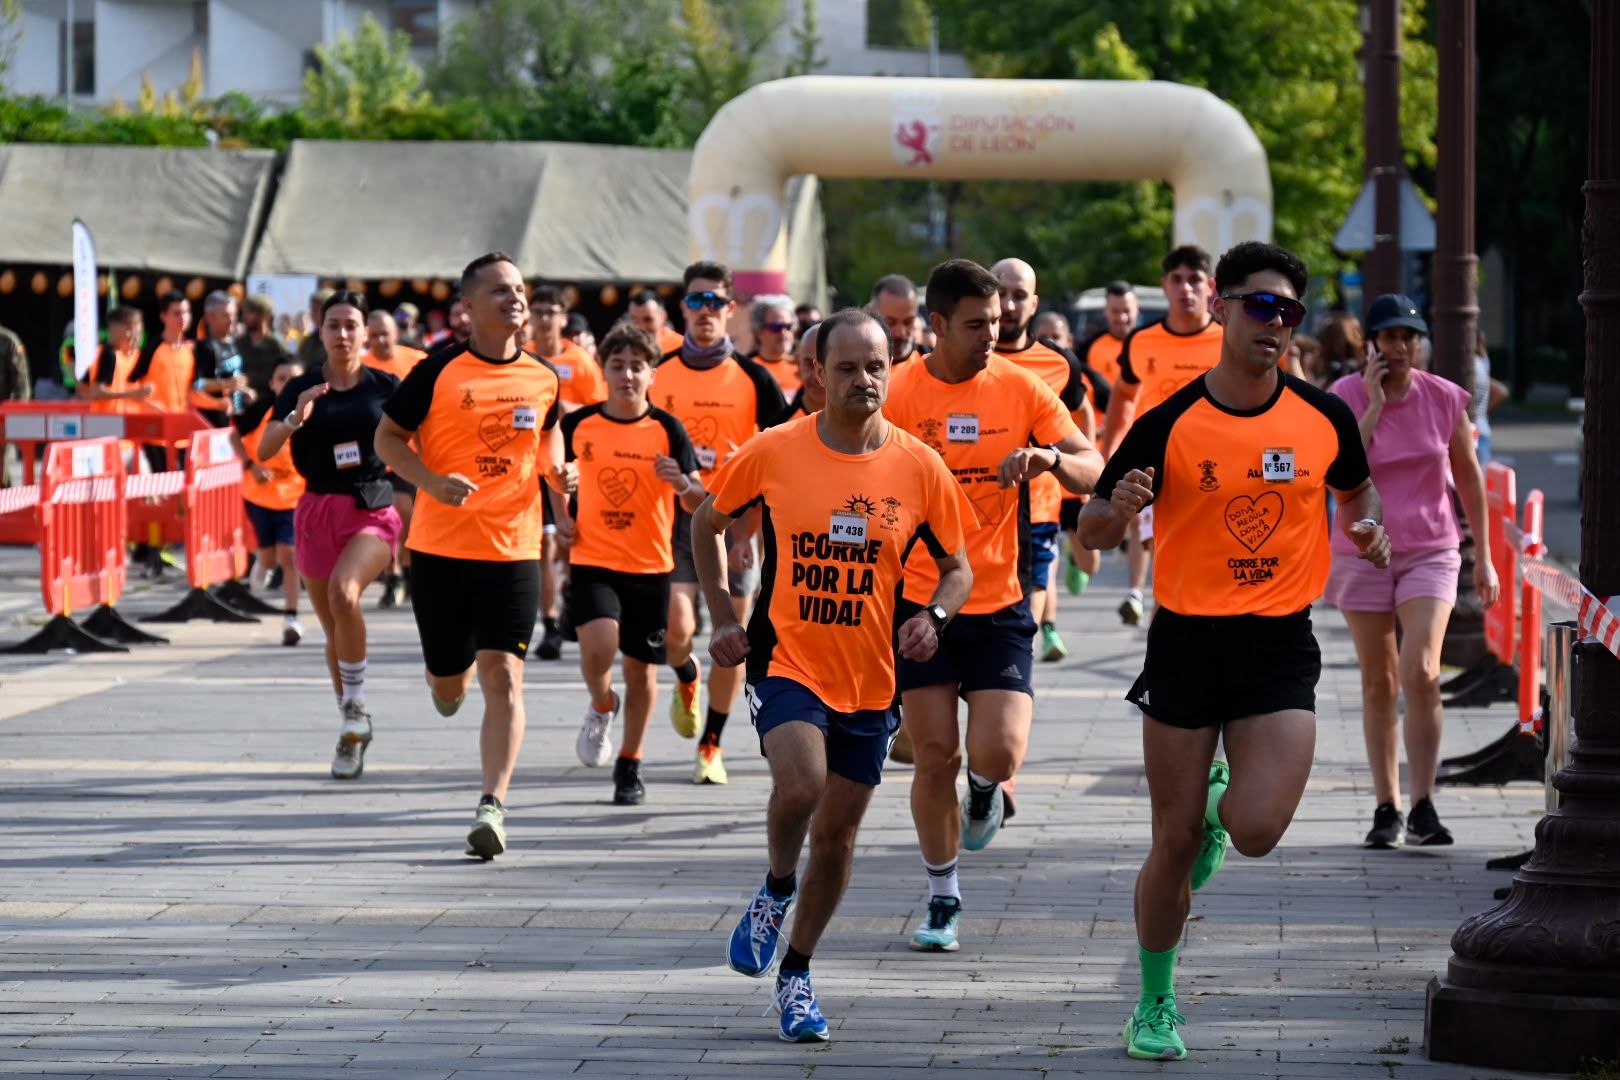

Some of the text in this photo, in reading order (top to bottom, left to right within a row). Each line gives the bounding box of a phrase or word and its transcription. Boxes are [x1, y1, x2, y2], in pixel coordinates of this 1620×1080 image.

[949, 113, 1075, 132] DIPUTACIÓN
[949, 133, 1036, 152] DE LEÓN
[961, 425, 976, 434] 209
[1264, 462, 1291, 472] Nº 567
[1228, 505, 1254, 521] DONA
[1236, 507, 1270, 528] MEDULA
[832, 524, 864, 537] Nº 438
[1240, 519, 1265, 537] DONA
[1247, 524, 1270, 544] VIDA
[1227, 556, 1279, 569] CORRE POR
[791, 562, 874, 596] POR LA
[1233, 568, 1274, 580] LA VIDA
[799, 595, 863, 627] VIDA!
